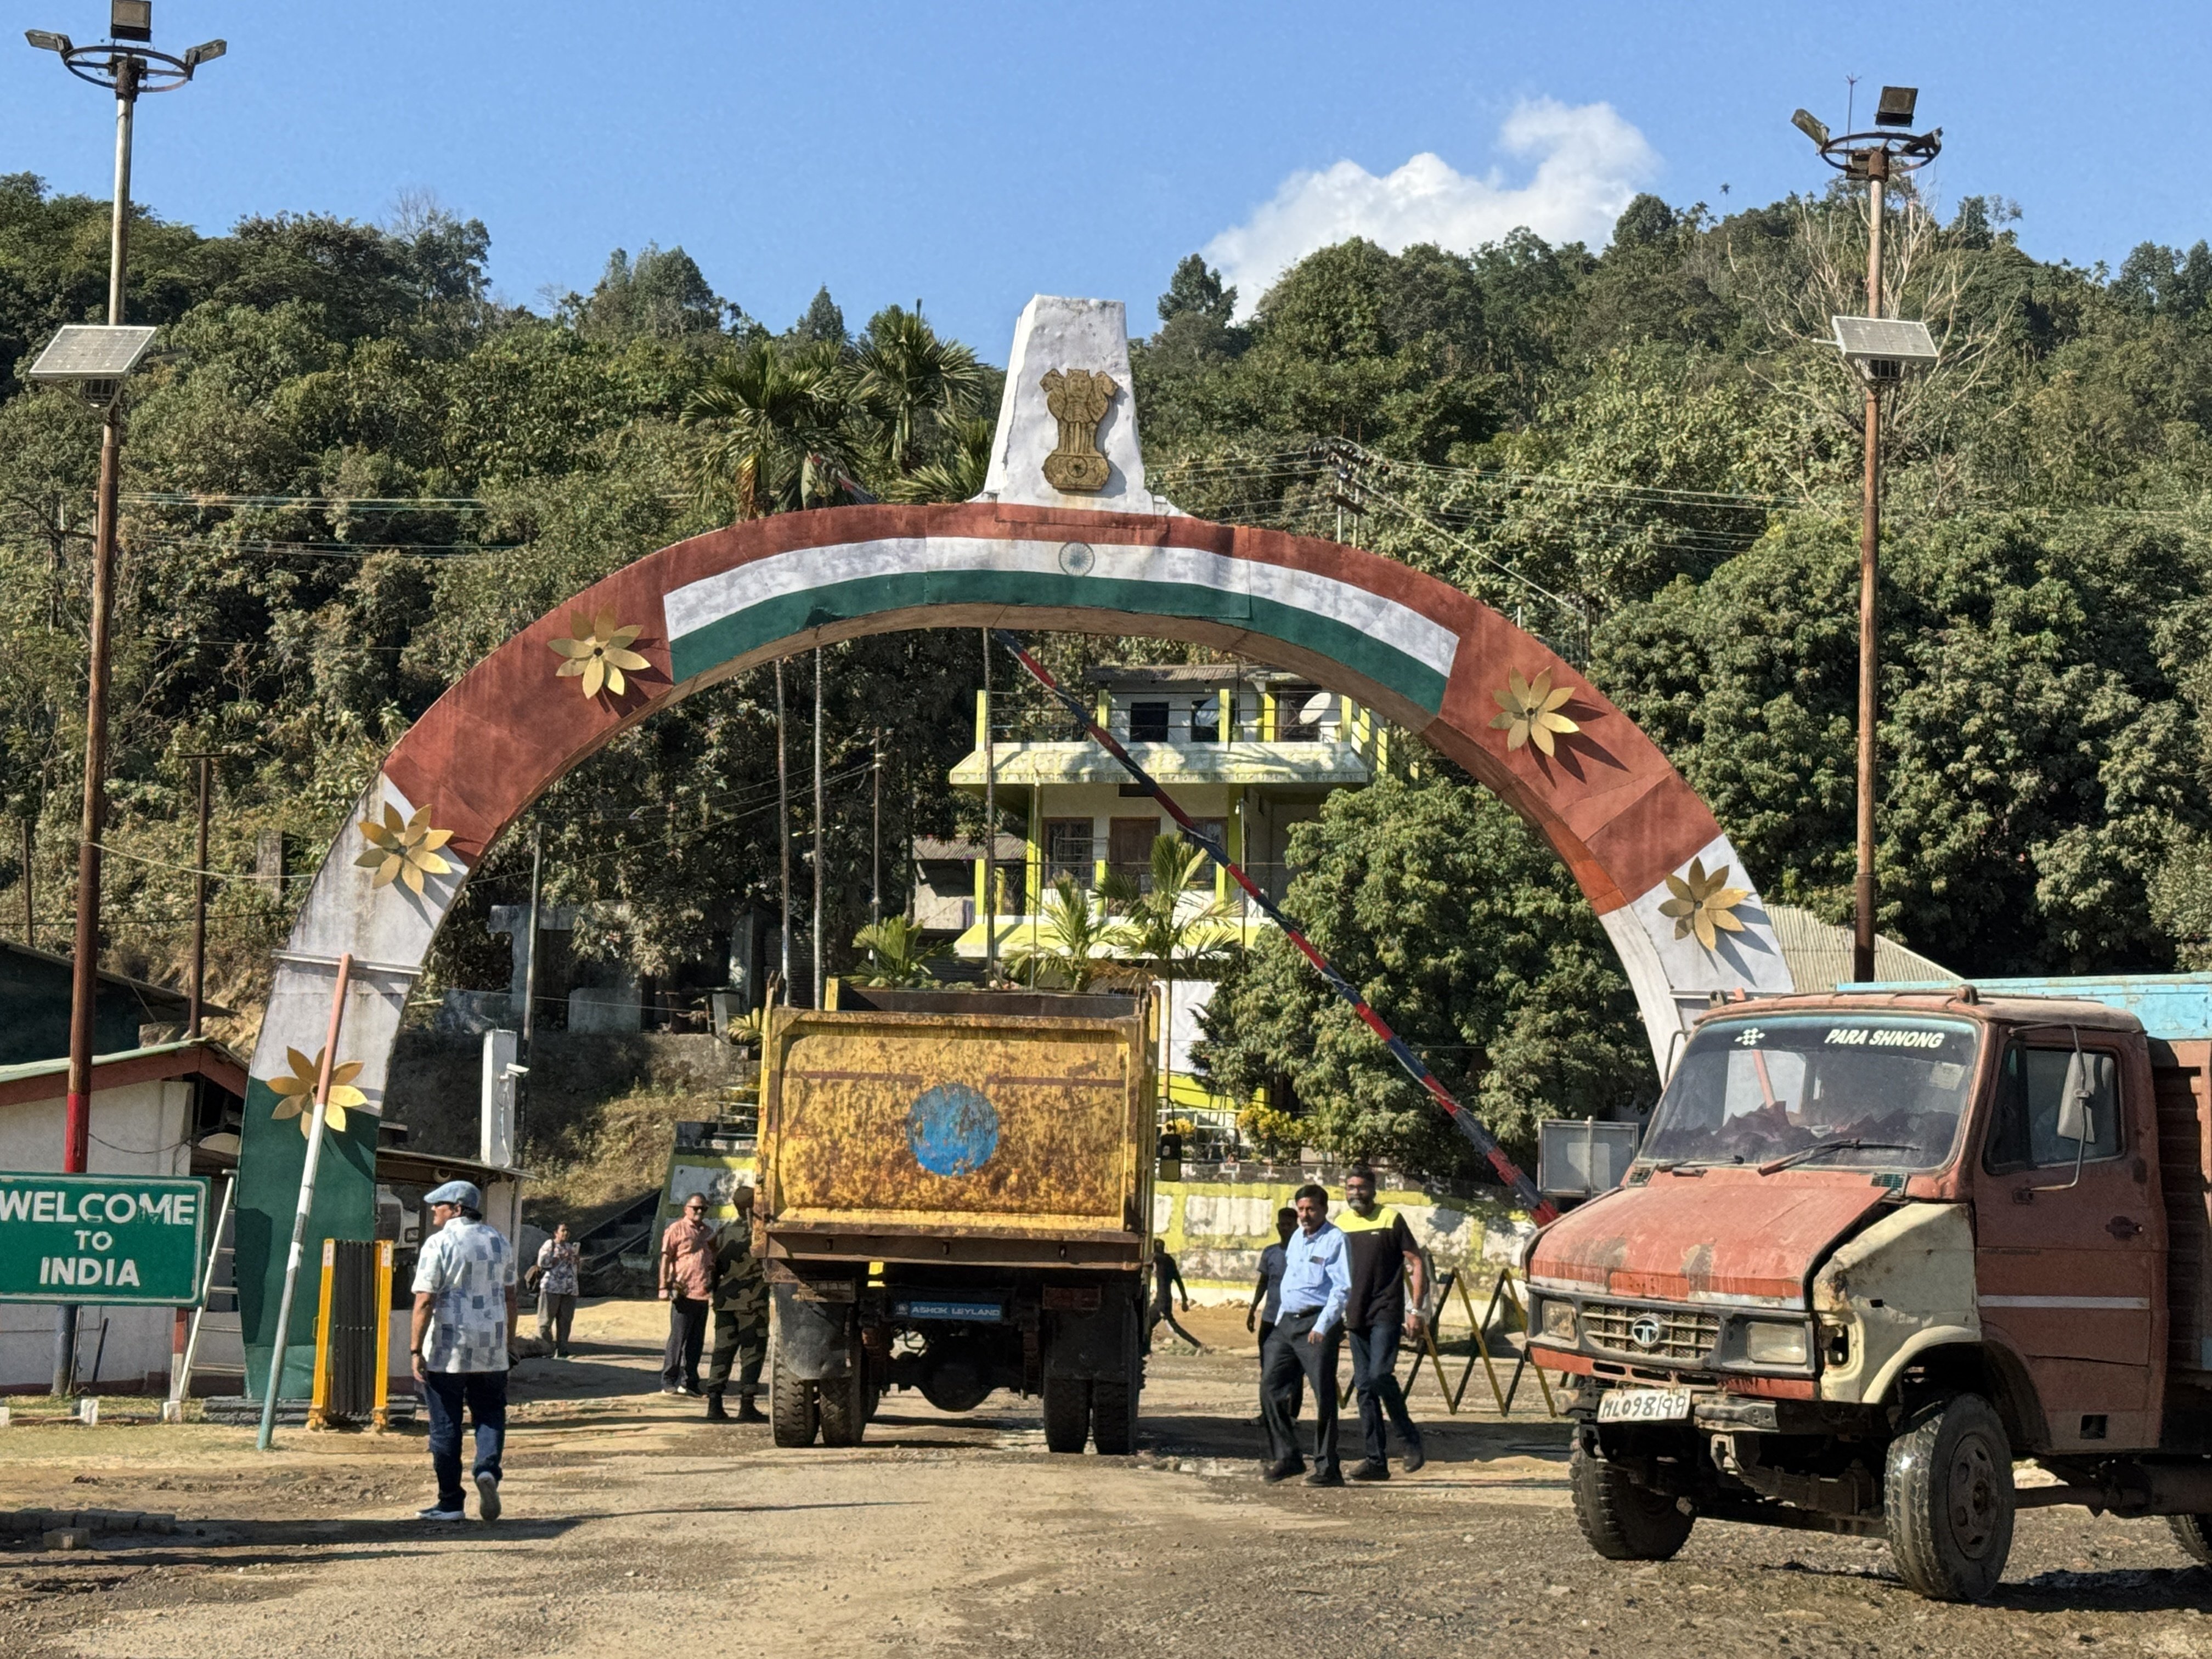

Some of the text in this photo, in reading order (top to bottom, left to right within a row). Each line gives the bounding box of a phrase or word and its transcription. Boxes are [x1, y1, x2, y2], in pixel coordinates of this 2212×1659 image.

[1824, 1029, 1945, 1048] PARA SHNONG
[0, 1190, 195, 1226] WELCOME
[74, 1229, 113, 1251] TO
[40, 1257, 140, 1287] INDIA
[911, 1306, 1000, 1316] ASHOK LEYLAND
